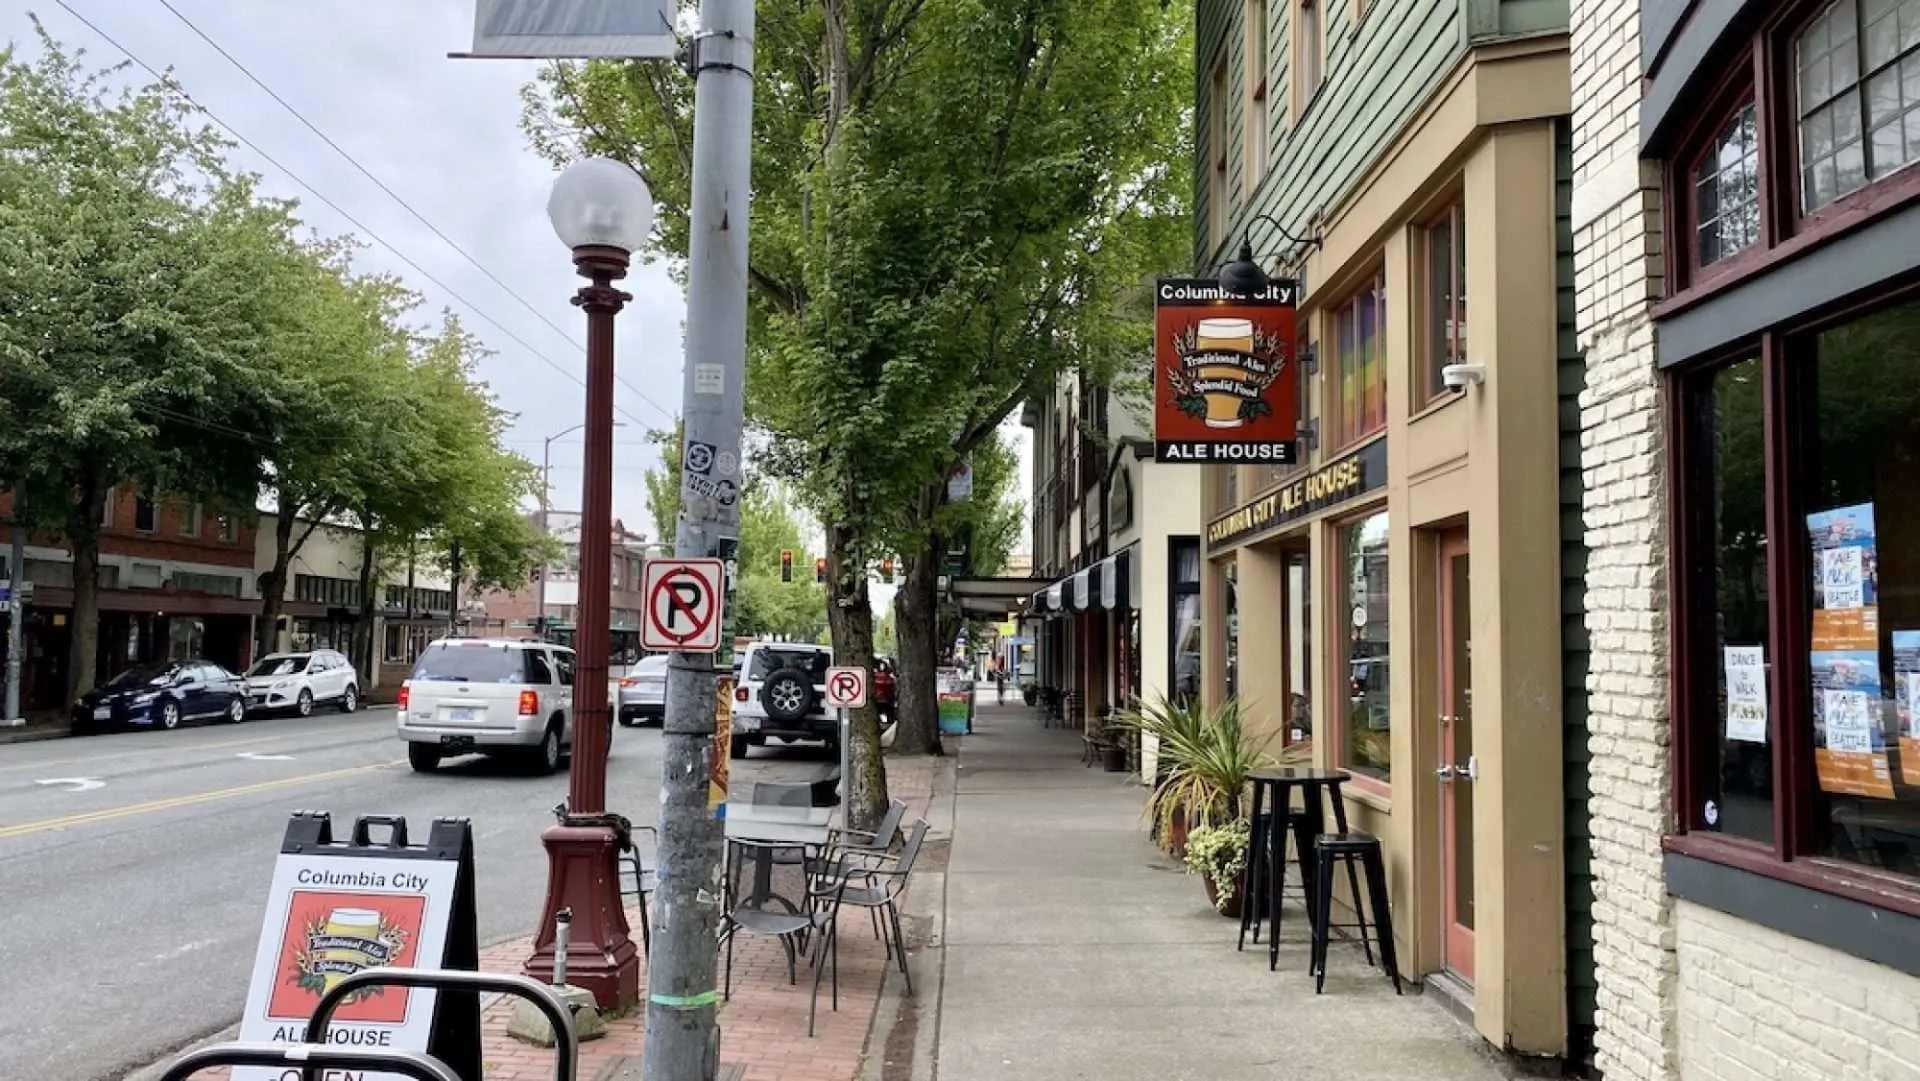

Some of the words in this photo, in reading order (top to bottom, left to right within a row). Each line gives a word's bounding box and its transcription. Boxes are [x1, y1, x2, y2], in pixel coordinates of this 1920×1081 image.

[1166, 444, 1208, 459] ALE
[1214, 444, 1285, 459] HOUSE
[1253, 494, 1278, 525] CITY
[1280, 483, 1303, 513] ALE
[1306, 455, 1361, 502] HOUSE
[298, 868, 385, 887] Columbia
[392, 872, 428, 891] City
[280, 1069, 364, 1081] OEN
